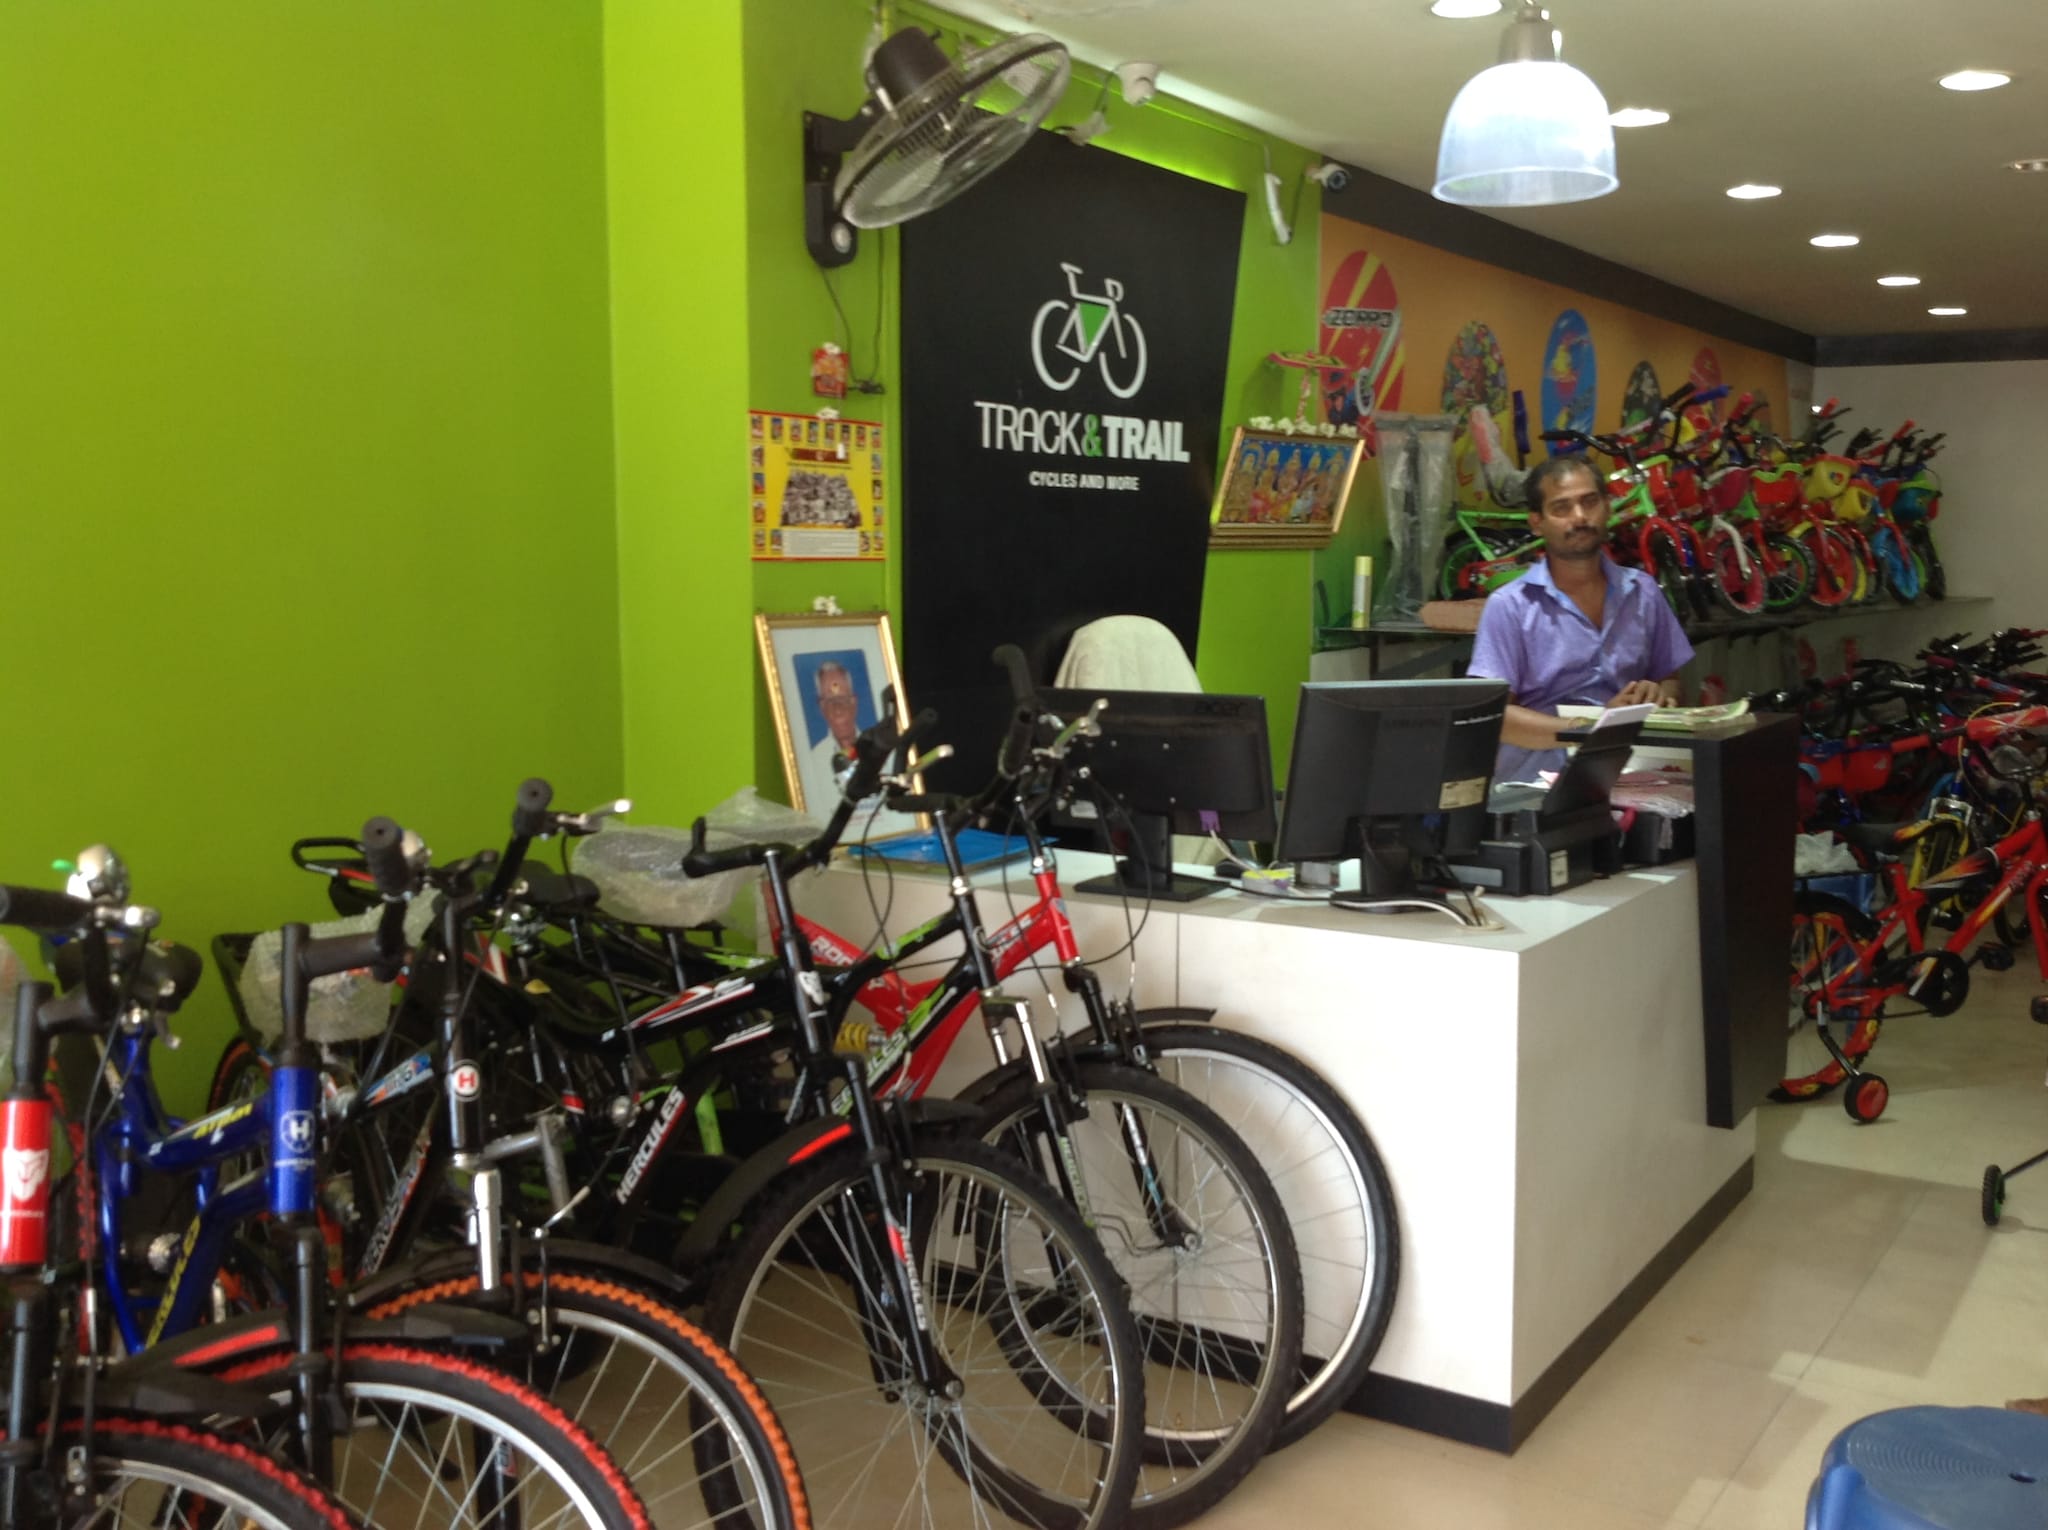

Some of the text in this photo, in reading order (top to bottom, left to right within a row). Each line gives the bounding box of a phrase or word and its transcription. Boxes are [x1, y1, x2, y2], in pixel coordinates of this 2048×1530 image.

[1028, 470, 1140, 491] CYCLES AND MORE
[616, 1085, 686, 1205] HERCULES
